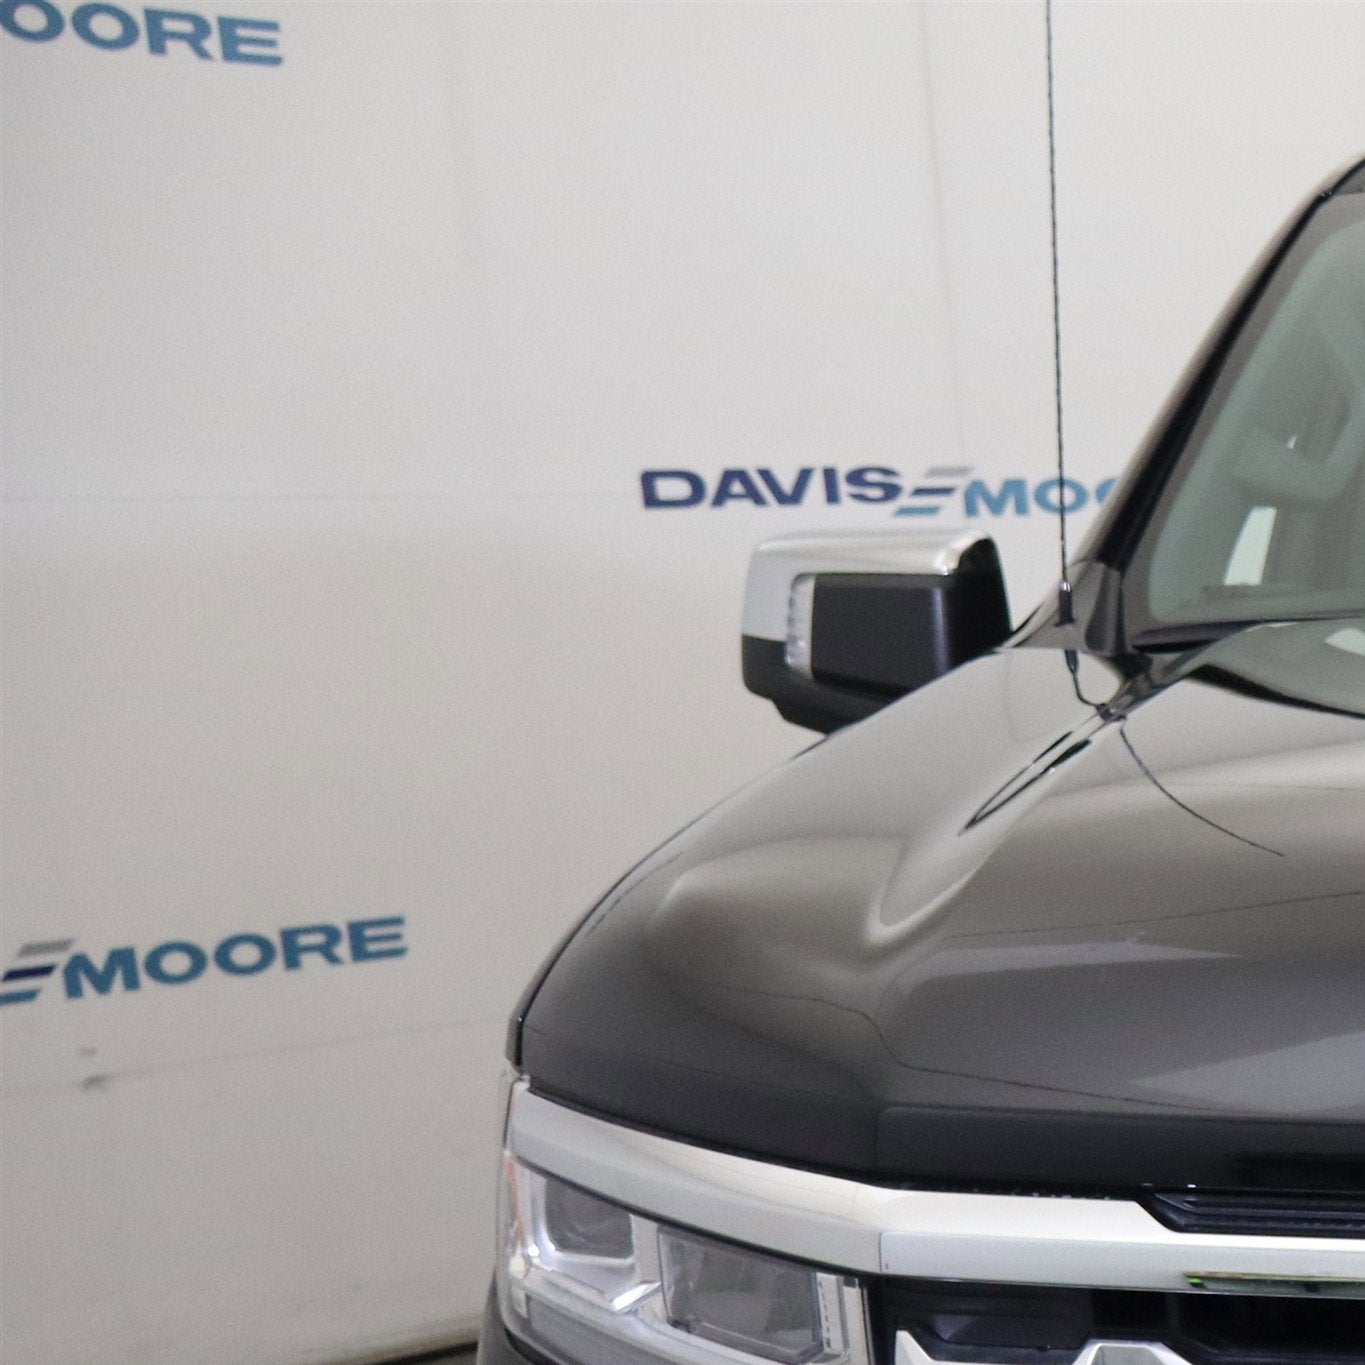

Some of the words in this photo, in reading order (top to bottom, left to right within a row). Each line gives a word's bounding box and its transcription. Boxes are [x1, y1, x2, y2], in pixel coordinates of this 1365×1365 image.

[0, 0, 283, 66] OORE
[639, 466, 902, 510] DAVIS
[62, 916, 409, 999] MOORE
